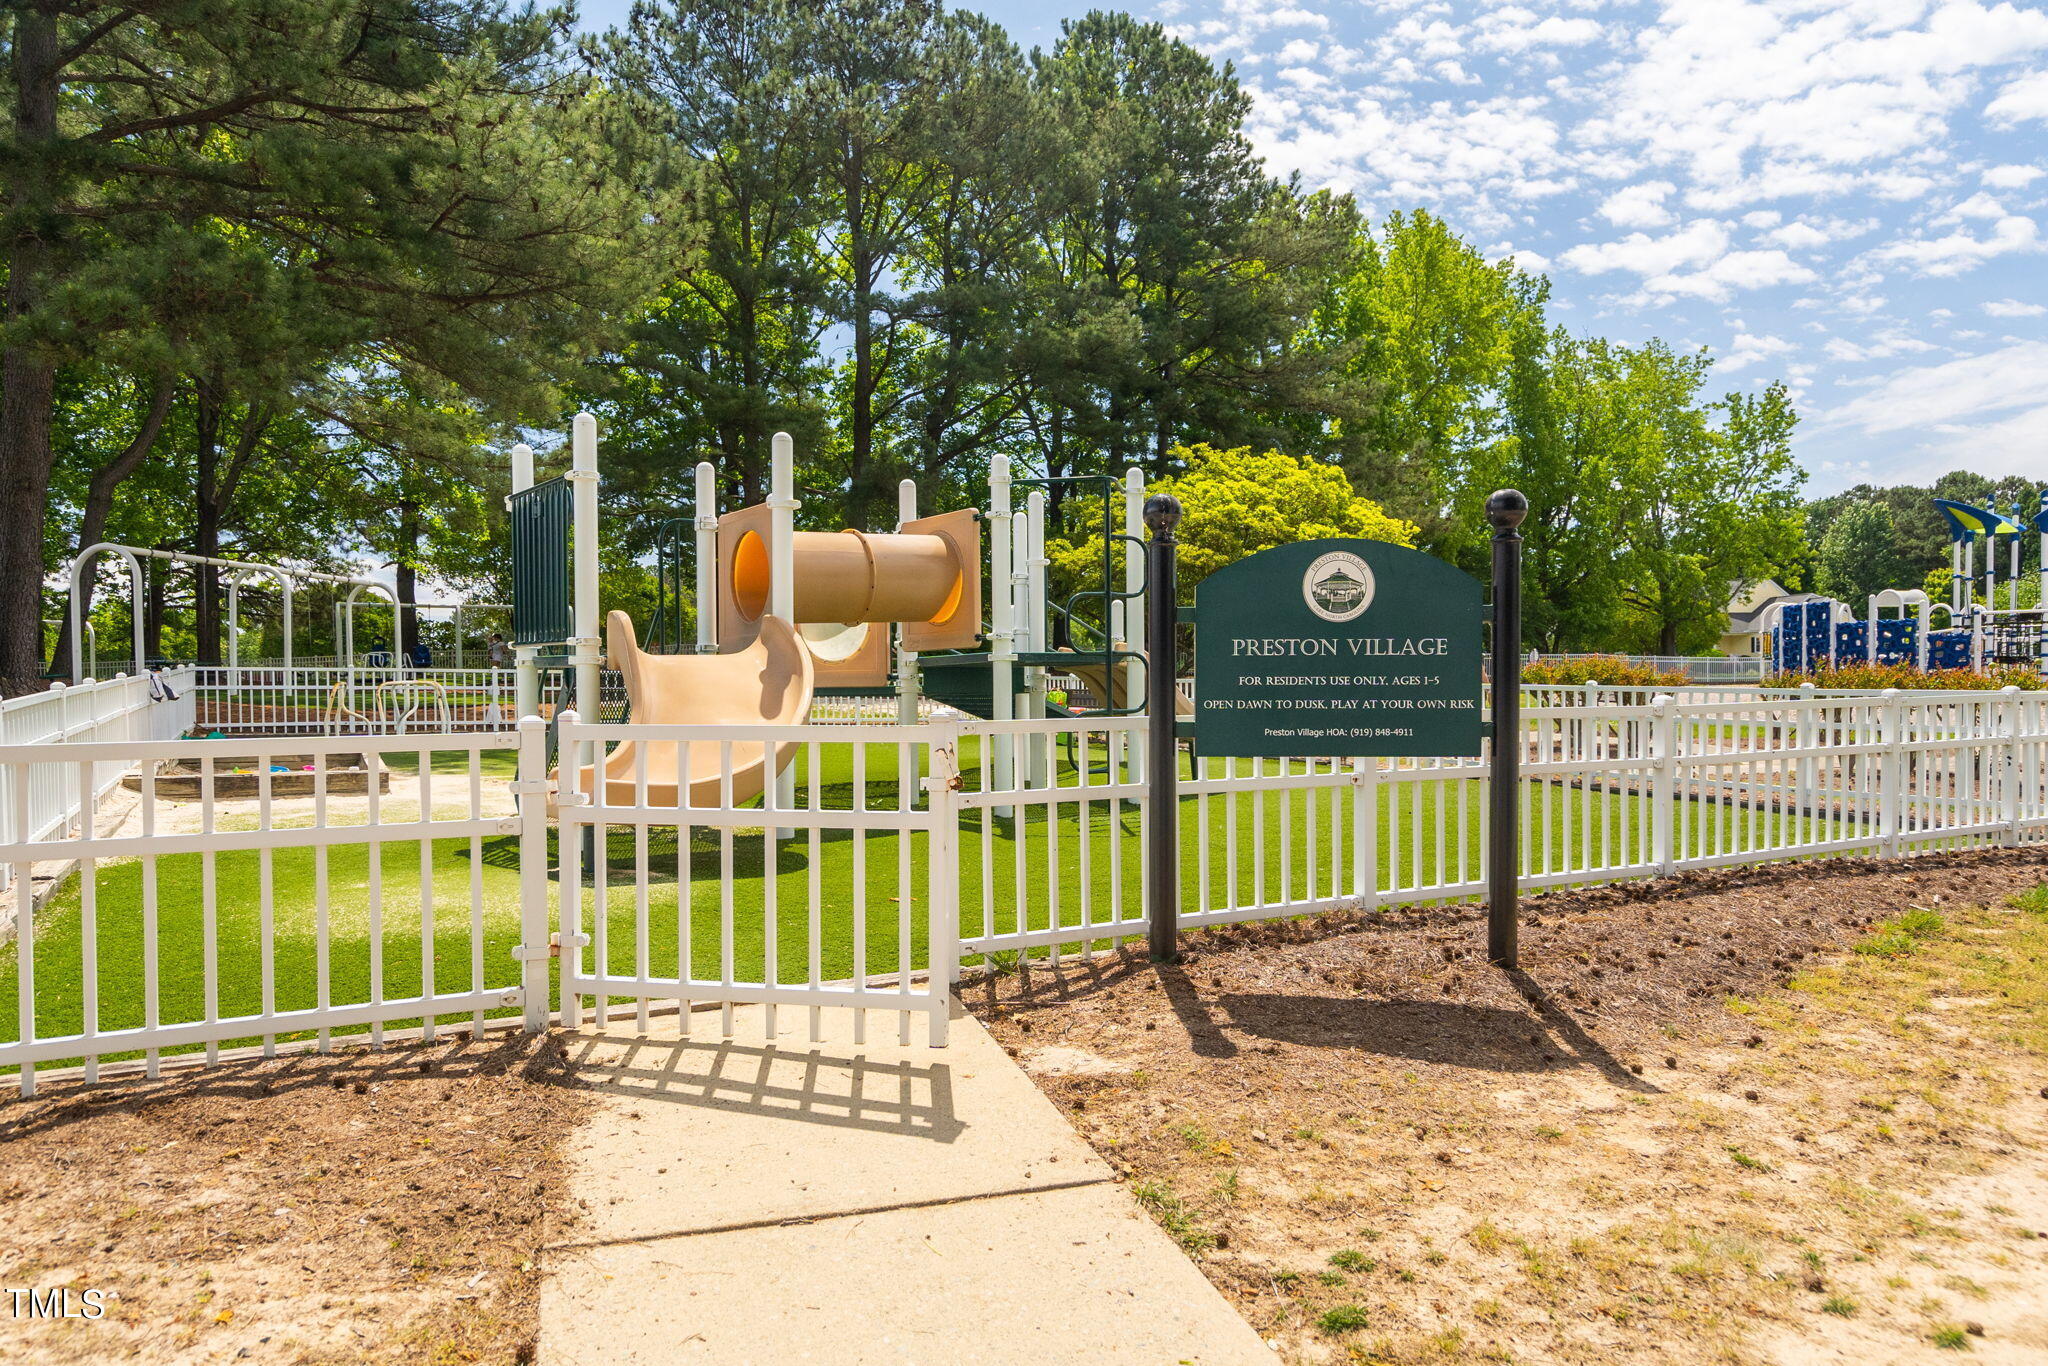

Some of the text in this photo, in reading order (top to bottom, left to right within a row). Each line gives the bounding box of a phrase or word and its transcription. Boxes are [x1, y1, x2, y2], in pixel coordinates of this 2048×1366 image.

[1310, 553, 1367, 572] PRESTON VILLAGE
[1231, 638, 1448, 656] PRESTON VILLAGE
[1239, 676, 1262, 686] FOR
[1266, 676, 1327, 686] RESIDENTS
[1330, 676, 1351, 686] USE
[1392, 676, 1421, 686] AGES
[1424, 676, 1440, 686] 1-5
[1203, 699, 1233, 709] OPEN
[1237, 699, 1272, 709] DAWN
[1275, 699, 1292, 709] TO
[1331, 699, 1359, 709] PLAY
[1362, 699, 1378, 709] AT
[1381, 699, 1414, 709] YOUR
[1417, 699, 1446, 709] OWN
[1450, 699, 1475, 709] RISK
[1264, 728, 1414, 738] Preston Village HOA: (919) 848-4911
